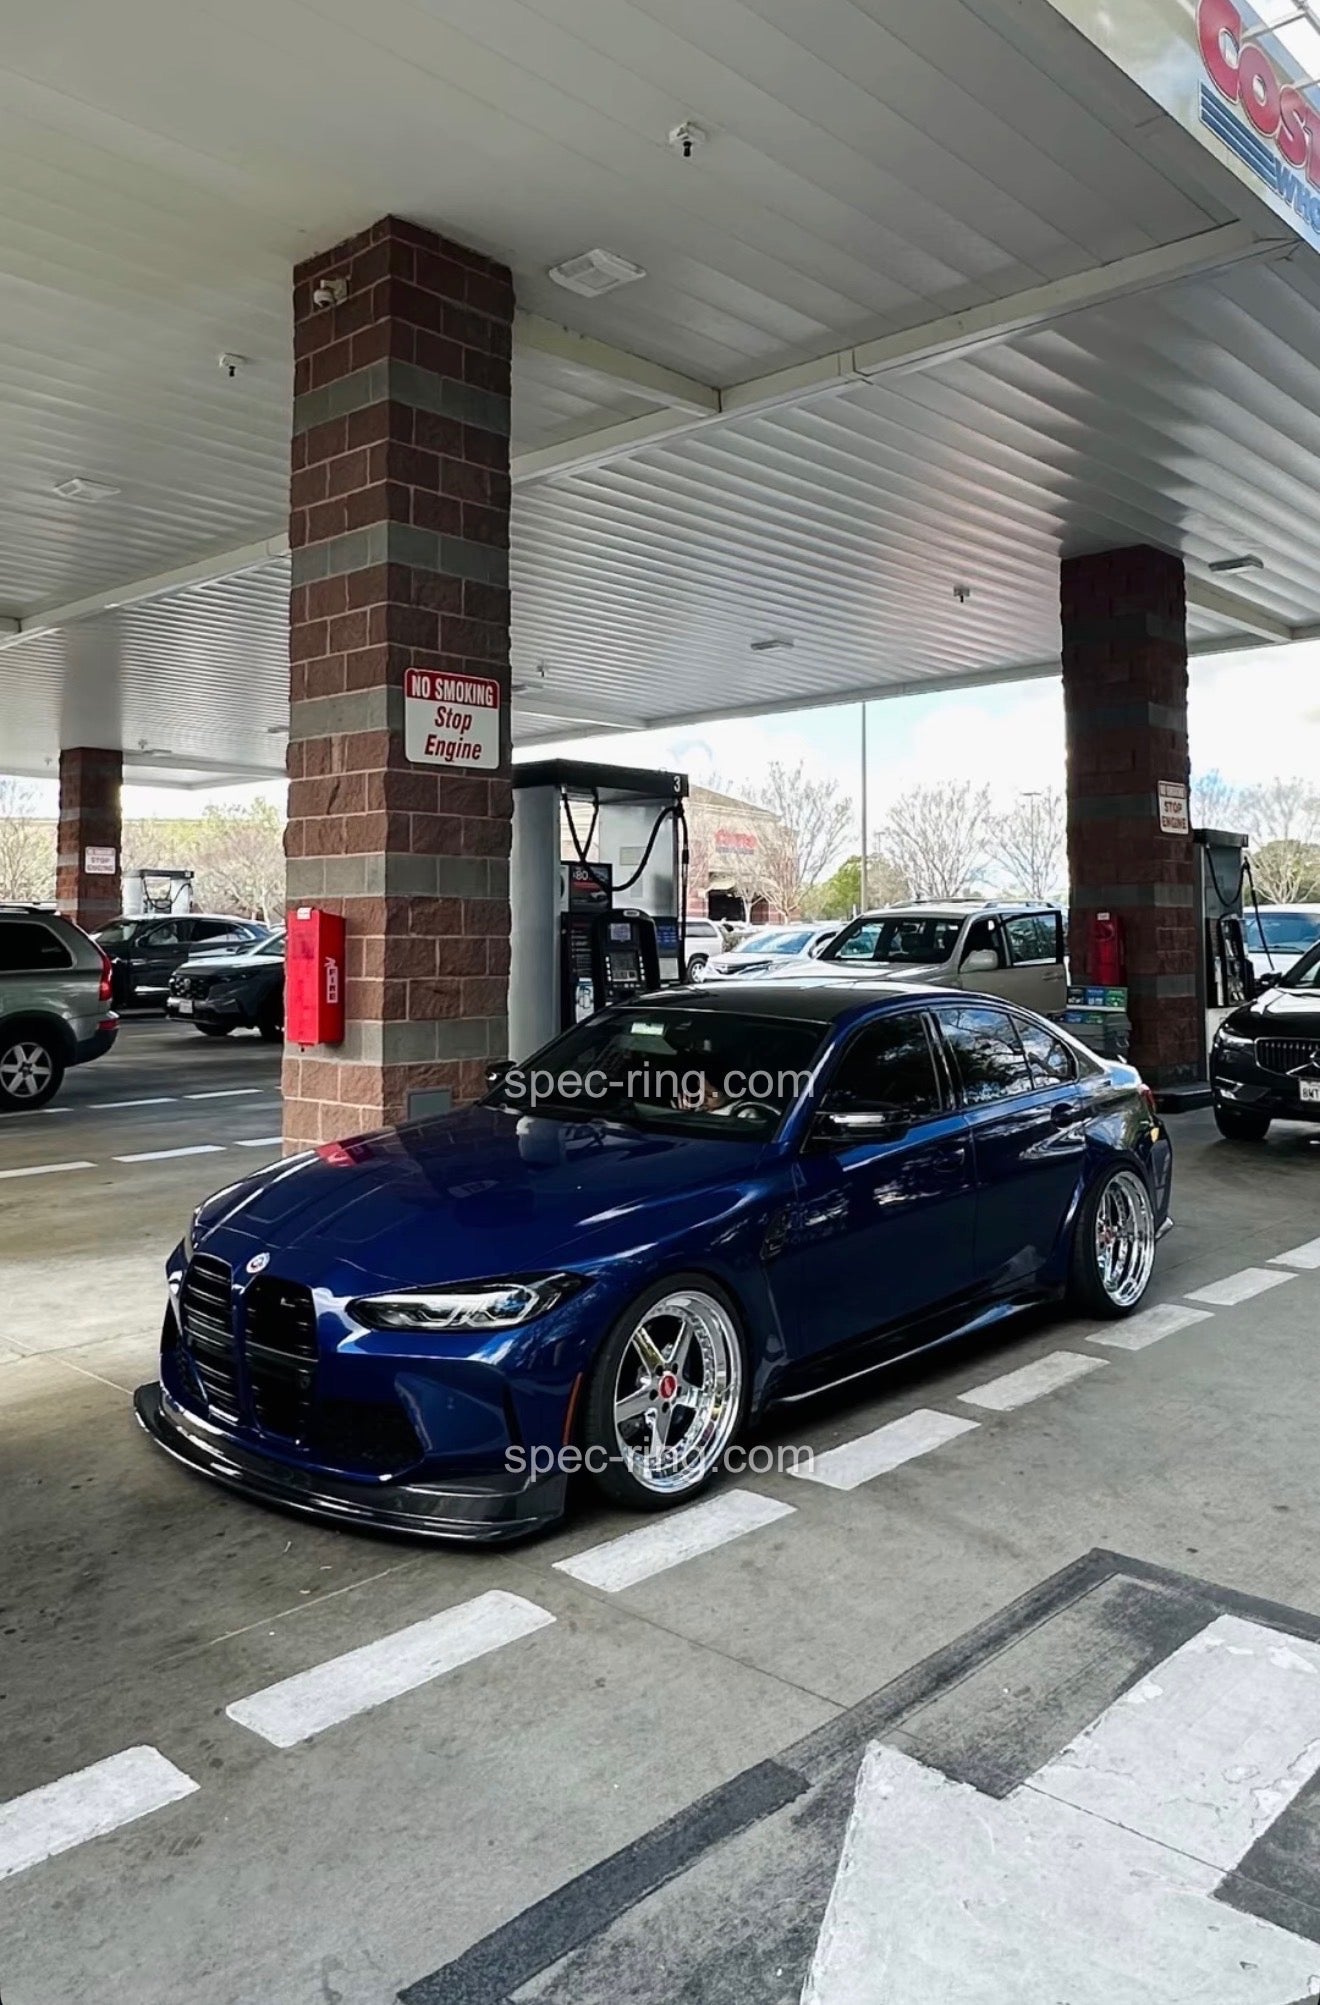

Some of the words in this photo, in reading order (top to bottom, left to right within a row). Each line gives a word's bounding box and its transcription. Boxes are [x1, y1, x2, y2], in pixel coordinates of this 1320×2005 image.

[412, 675, 431, 698] NO
[435, 677, 494, 706] SMOKING
[434, 705, 472, 735] Stop
[424, 734, 482, 762] Engine
[673, 775, 681, 793] 3
[1164, 800, 1182, 813] STOP
[1161, 815, 1187, 829] ENGINE
[329, 968, 337, 1001] FIRE
